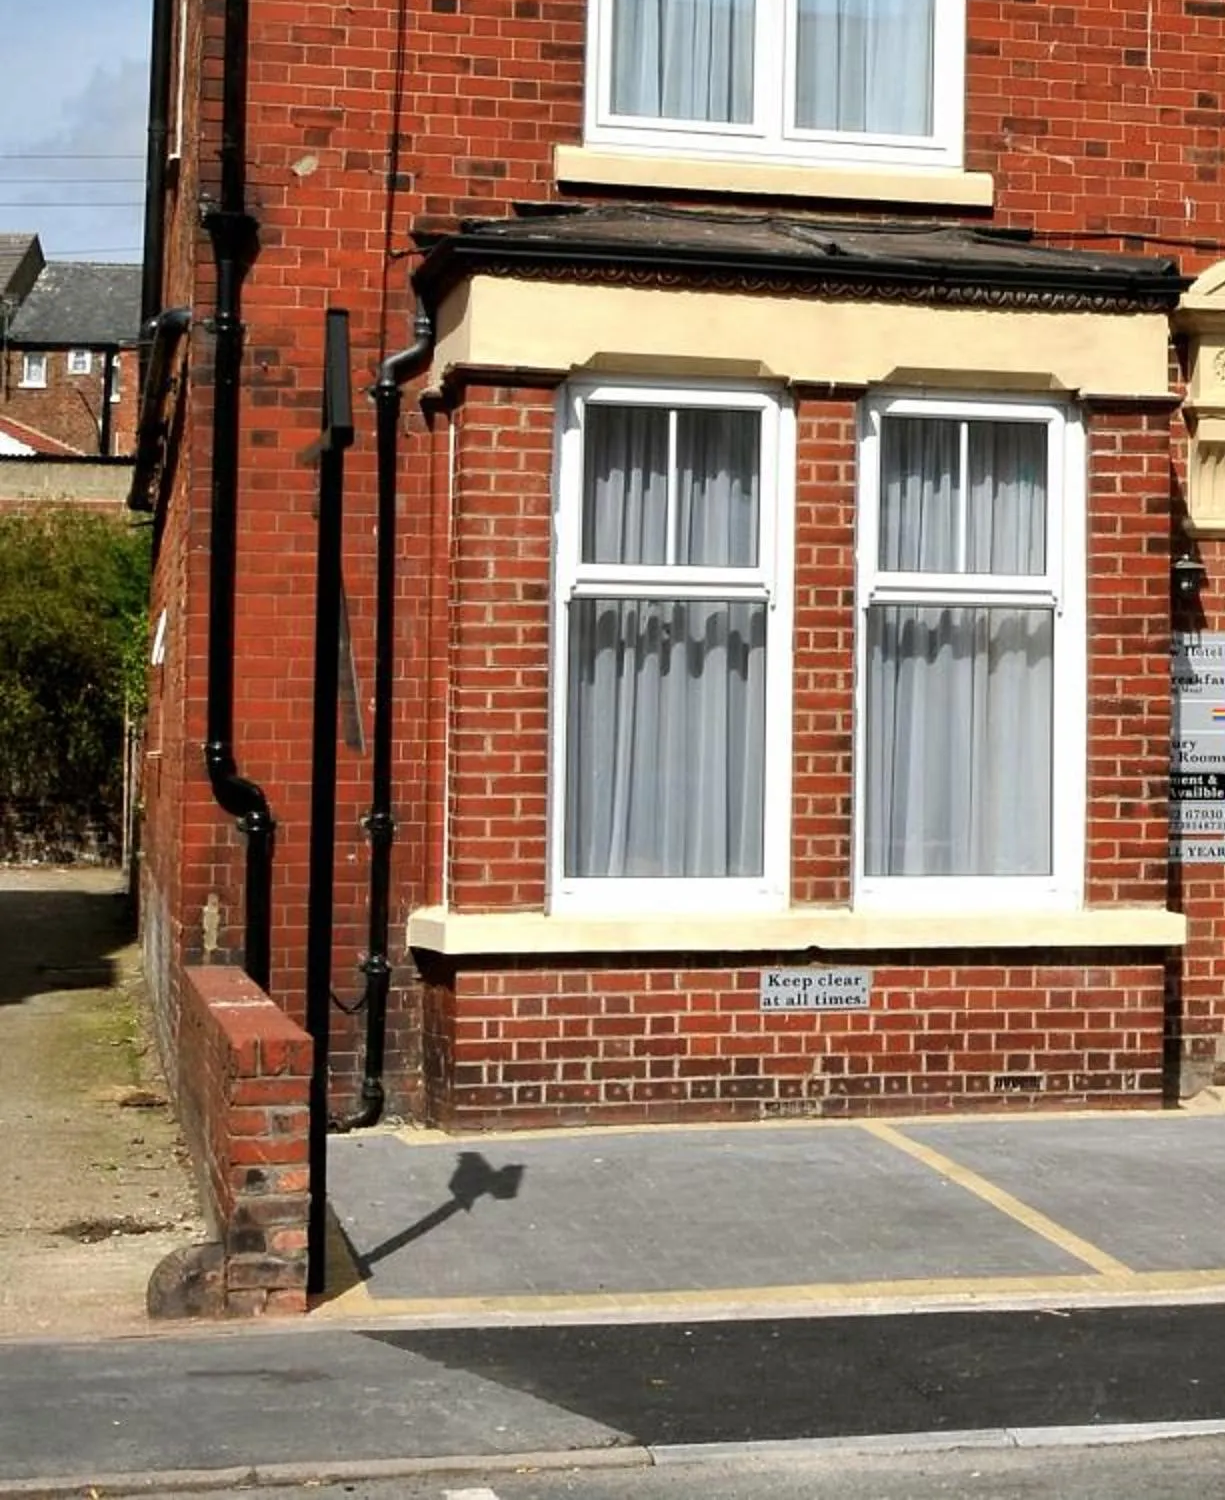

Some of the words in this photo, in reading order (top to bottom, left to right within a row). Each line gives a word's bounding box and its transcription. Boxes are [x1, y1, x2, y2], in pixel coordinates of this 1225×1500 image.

[1207, 774, 1217, 785] &
[768, 973, 813, 991] Keep
[817, 973, 862, 987] clear
[763, 995, 780, 1006] at
[785, 993, 808, 1006] all
[815, 991, 866, 1006] times.
